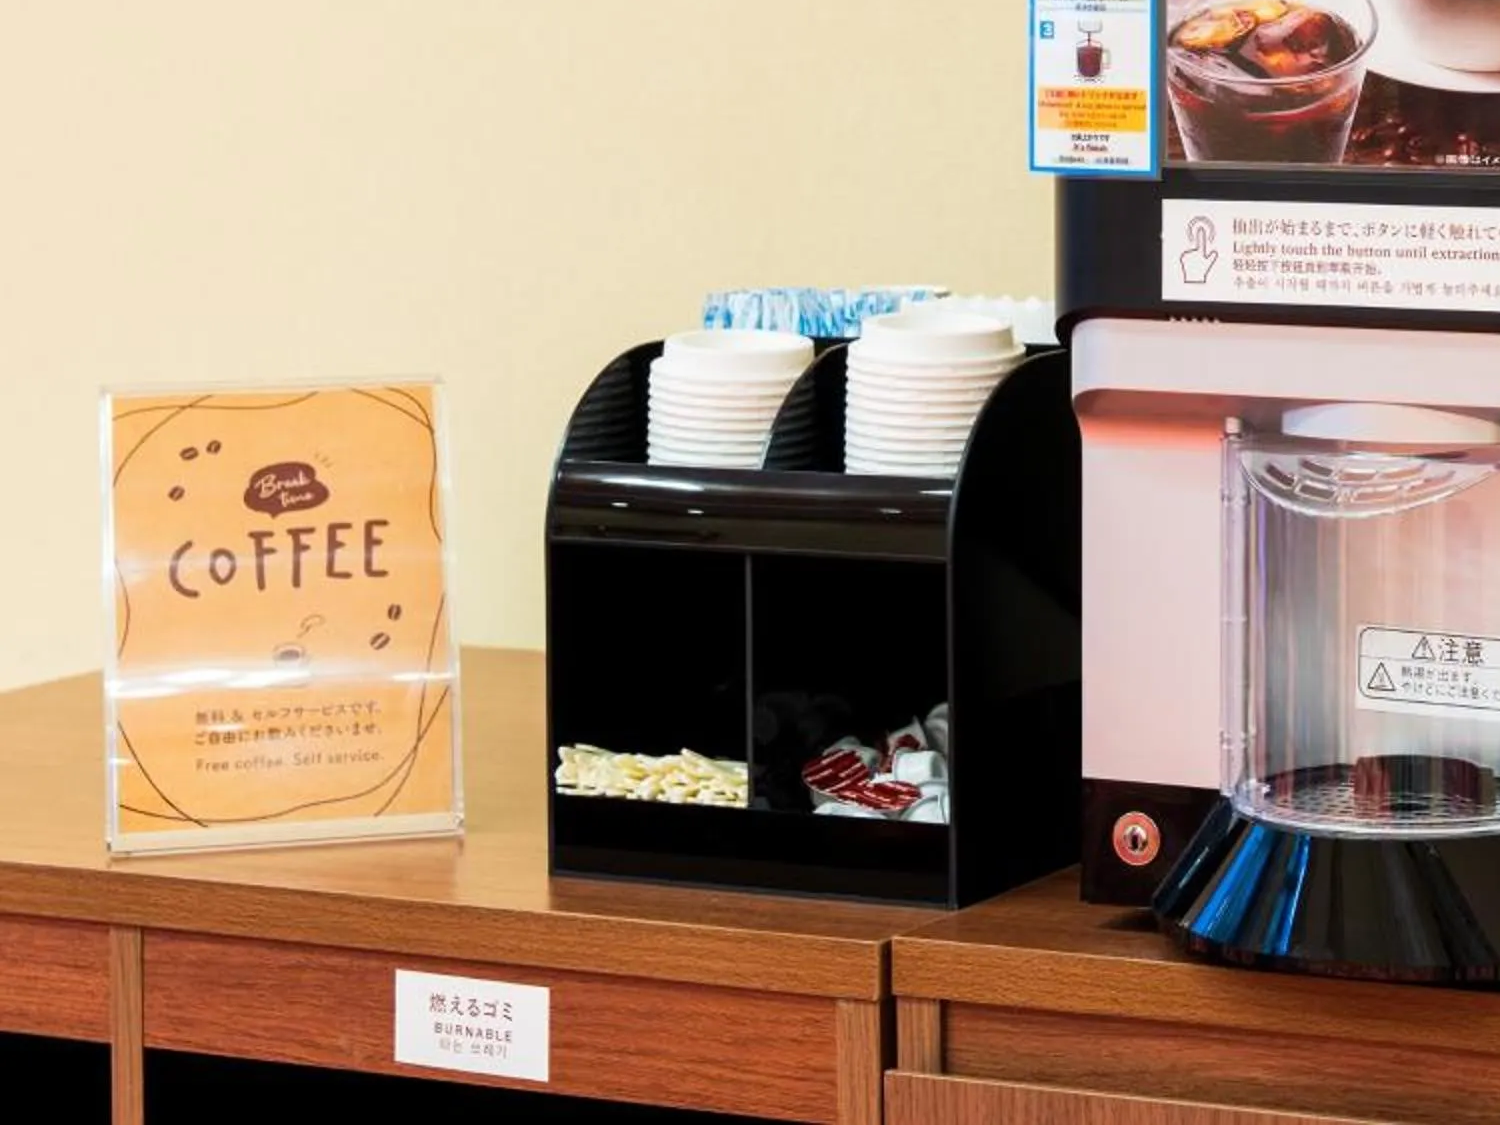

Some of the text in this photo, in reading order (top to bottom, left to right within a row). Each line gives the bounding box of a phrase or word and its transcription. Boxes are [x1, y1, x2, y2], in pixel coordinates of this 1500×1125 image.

[1233, 241, 1277, 257] Lightly
[1281, 243, 1318, 256] touch
[1322, 244, 1343, 256] the
[1347, 245, 1390, 258] button
[1395, 247, 1427, 259] until
[1431, 248, 1500, 261] extraction
[253, 469, 312, 500] Break
[169, 519, 389, 598] COFFEE
[1438, 636, 1486, 666] 注意
[196, 758, 230, 773] Free
[293, 751, 323, 767] Self
[429, 992, 513, 1023] 燃えるゴミ
[434, 1021, 513, 1043] BURNABLE
